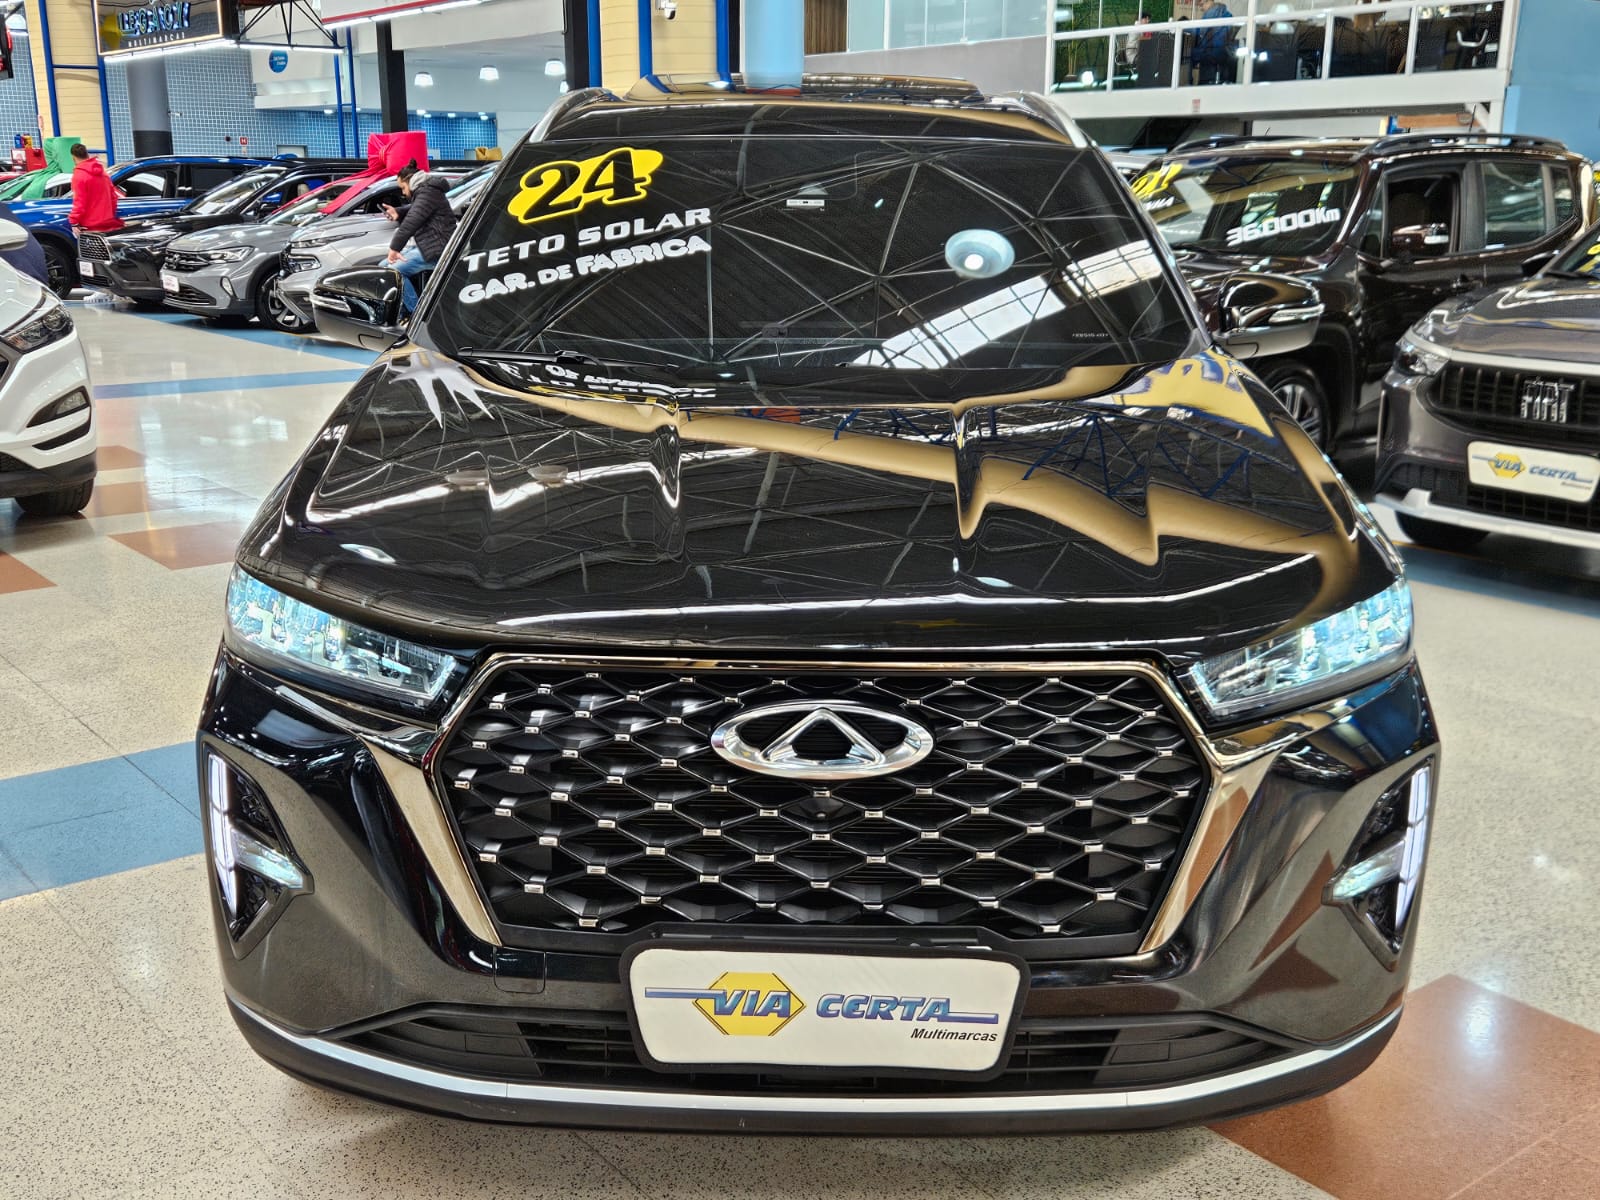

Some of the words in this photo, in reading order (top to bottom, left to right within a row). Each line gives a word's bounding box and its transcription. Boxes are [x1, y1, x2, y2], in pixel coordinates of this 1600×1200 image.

[118, 2, 191, 36] LEGACY
[513, 147, 656, 224] 24
[462, 234, 565, 273] TETO
[578, 207, 712, 247] SOLAR
[458, 273, 536, 304] GAR.
[537, 264, 574, 285] DE
[576, 235, 712, 276] FABRICA
[1494, 459, 1521, 472] VIA
[1529, 464, 1577, 481] CERTA
[711, 989, 792, 1018] VIA
[816, 993, 951, 1024] CERTA
[910, 1027, 998, 1042] Multimarcas
